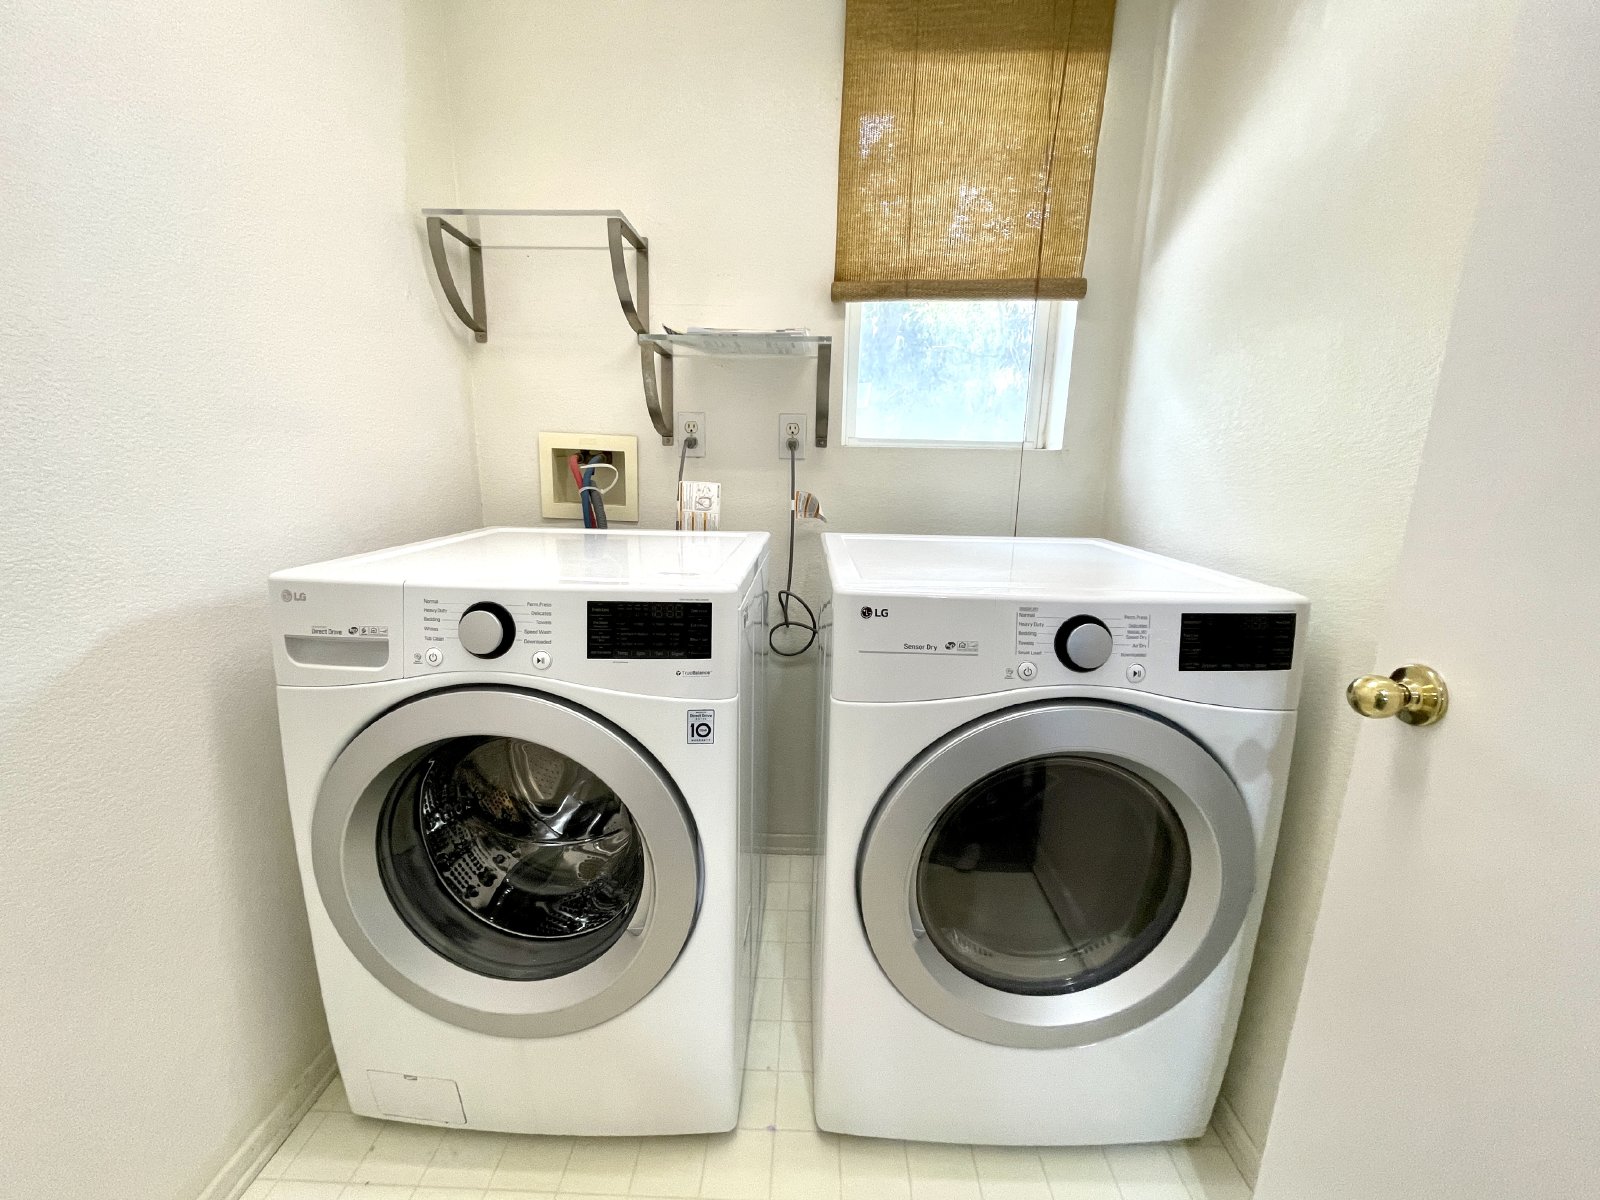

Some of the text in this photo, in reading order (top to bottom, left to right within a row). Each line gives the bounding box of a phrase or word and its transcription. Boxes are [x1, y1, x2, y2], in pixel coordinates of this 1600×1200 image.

[293, 592, 307, 601] LG
[874, 608, 889, 618] LG
[926, 643, 938, 651] Dry
[690, 722, 712, 738] 10
